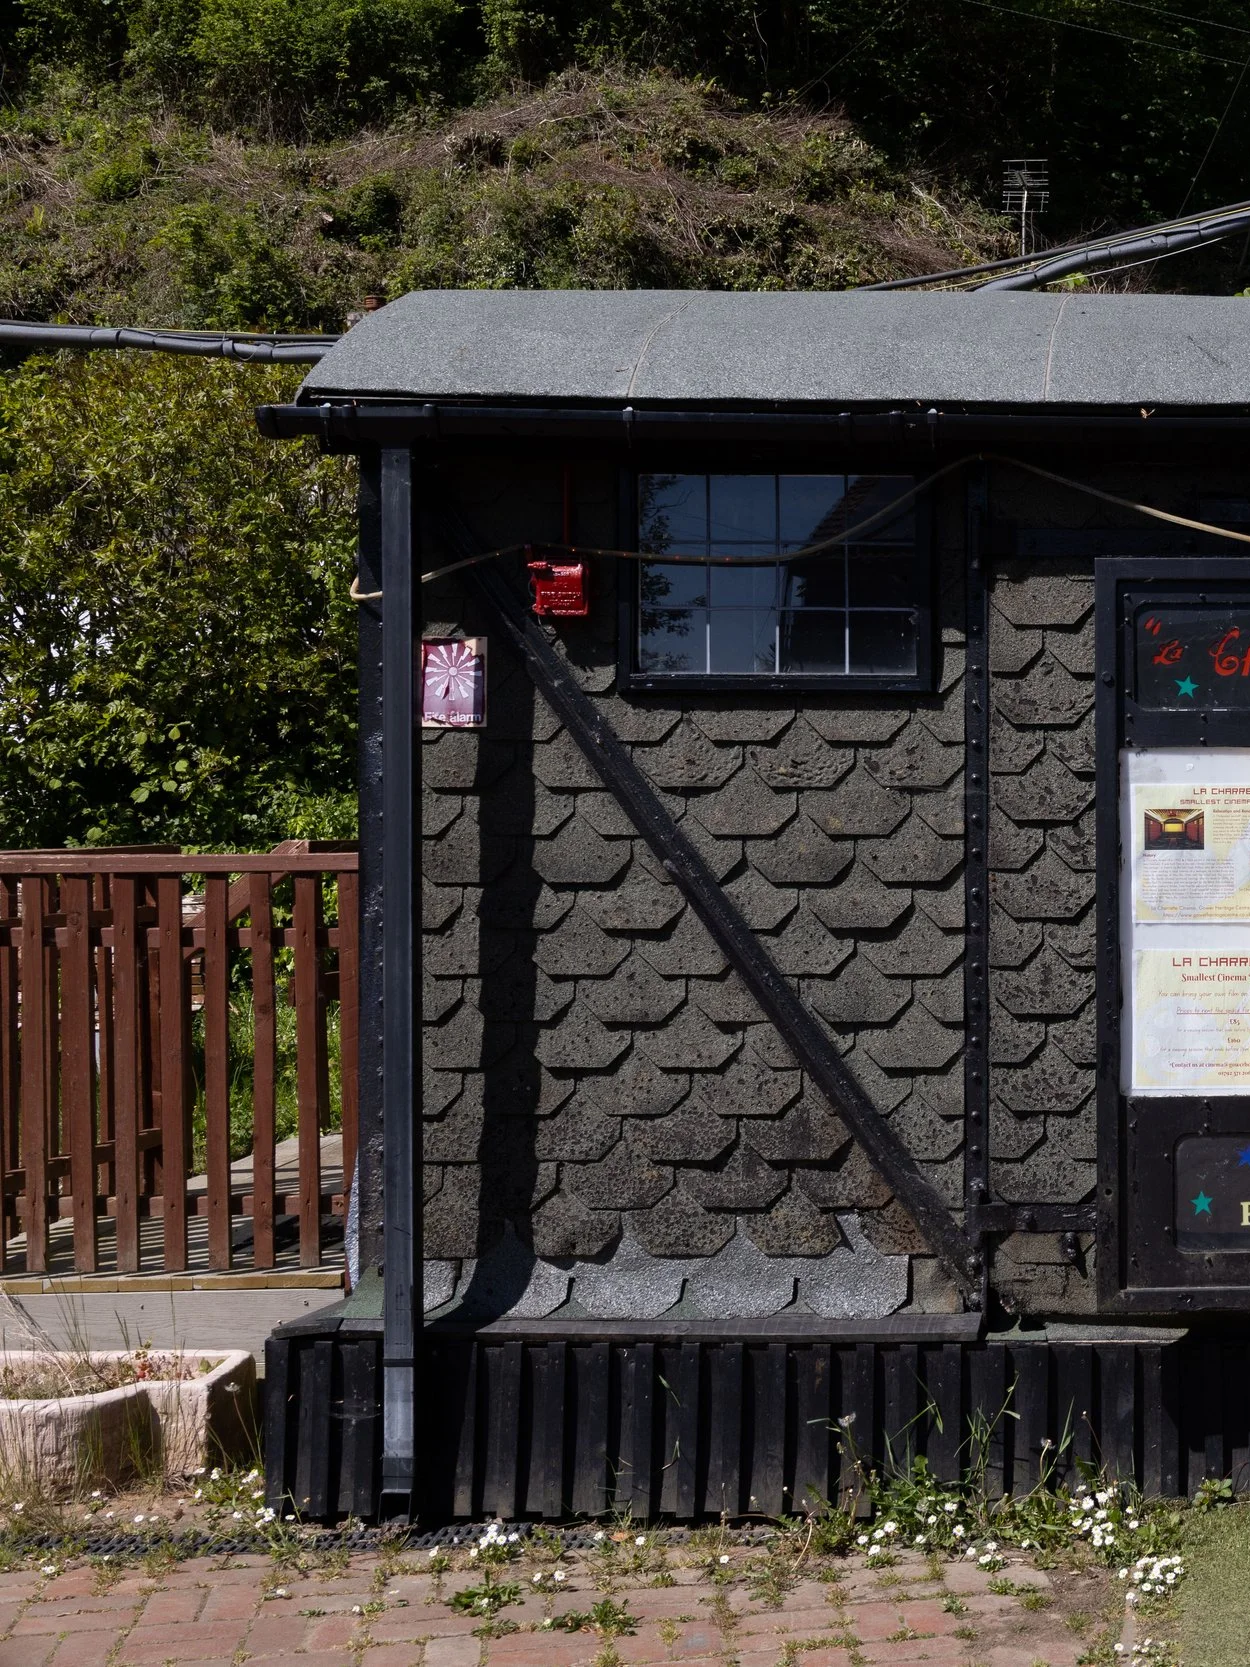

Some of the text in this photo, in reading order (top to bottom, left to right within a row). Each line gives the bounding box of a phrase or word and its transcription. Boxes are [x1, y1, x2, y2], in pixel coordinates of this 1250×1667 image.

[424, 712, 481, 722] Fire alarm
[1172, 958, 1192, 966] LA
[1181, 973, 1215, 982] Smallest
[1217, 973, 1246, 982] Cinema
[1182, 990, 1196, 999] bring
